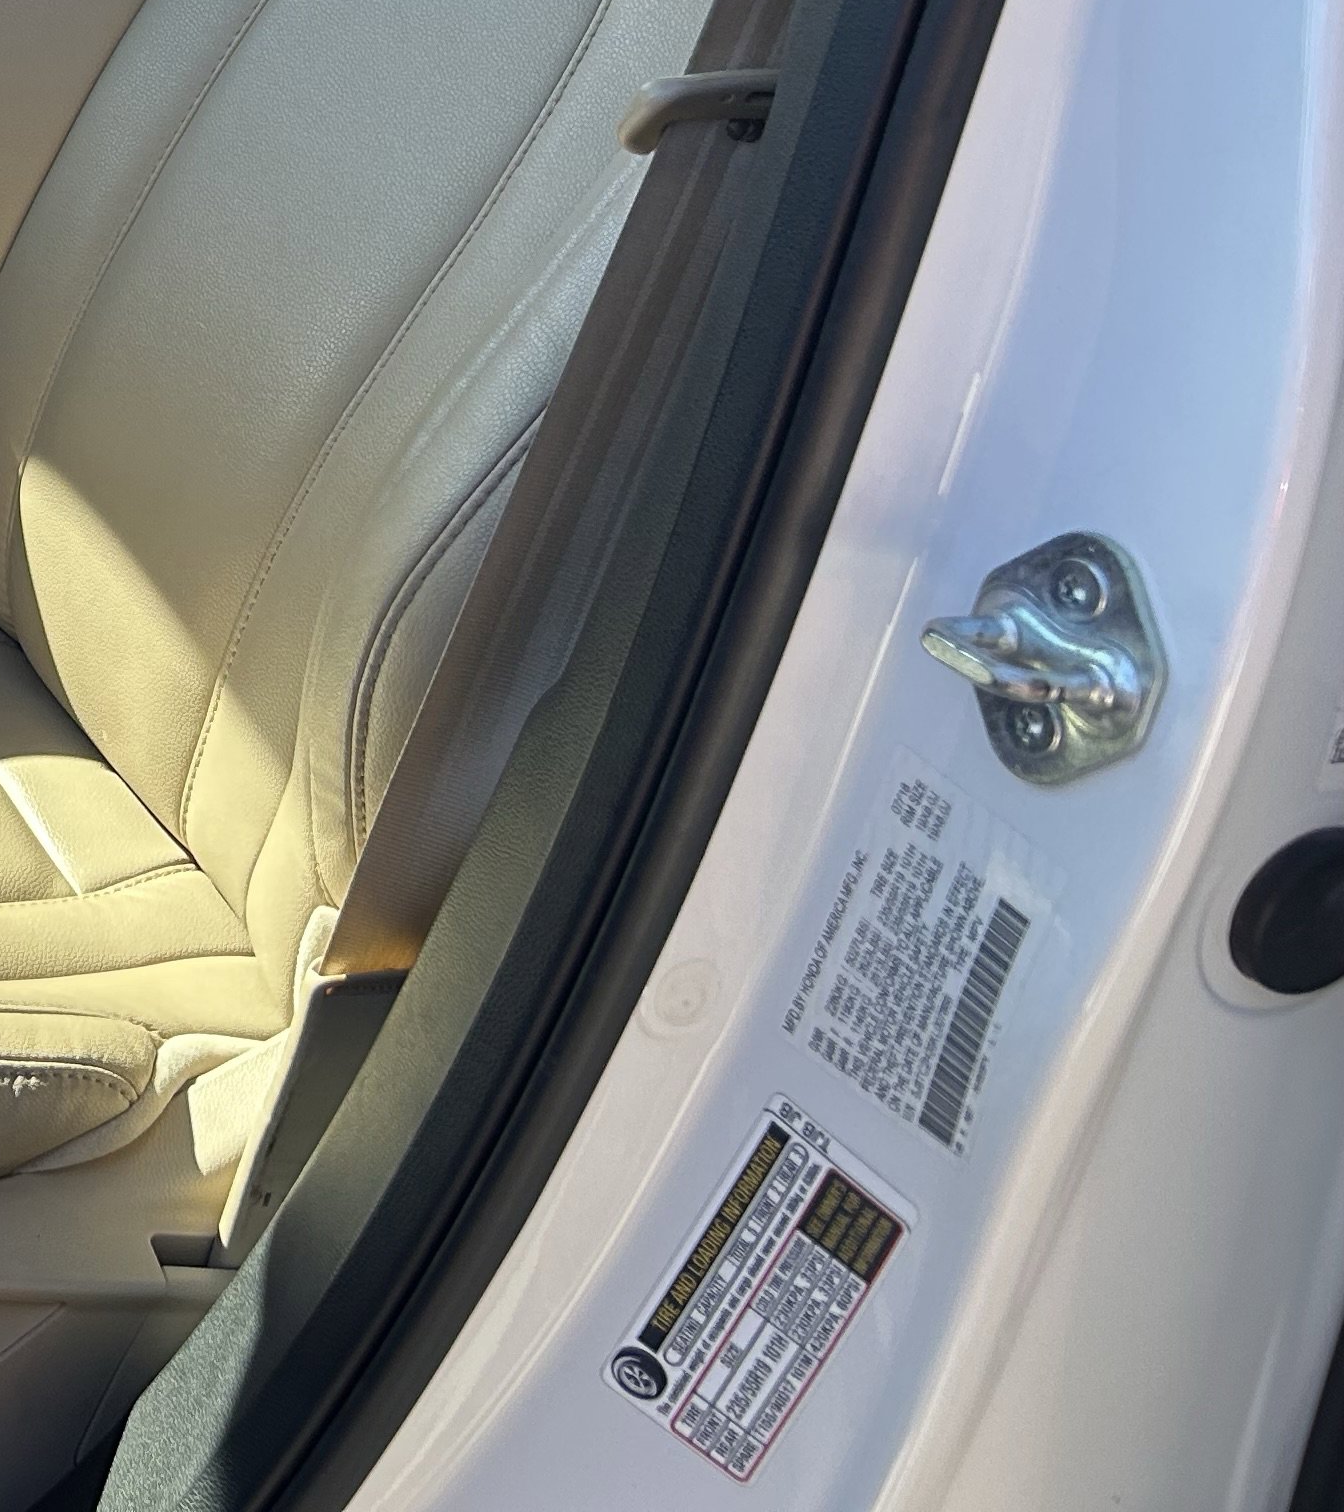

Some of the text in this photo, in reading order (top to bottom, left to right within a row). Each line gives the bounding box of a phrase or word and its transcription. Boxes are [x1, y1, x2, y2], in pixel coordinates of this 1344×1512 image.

[899, 777, 927, 829] RIM SIZE
[869, 846, 899, 900] TIRE SIZE
[908, 855, 944, 924] APPLICABLE
[945, 860, 972, 908] EFFECT
[819, 893, 849, 945] AMERICA
[901, 918, 918, 942] ALL
[943, 911, 968, 956] SHOWN
[812, 939, 830, 961] OF
[916, 916, 950, 983] STANDARDS
[797, 954, 823, 997] HONDA
[871, 953, 904, 1015] CONFORMS
[914, 953, 952, 1032] MANUFACTURE
[860, 922, 932, 1093] FEDERAL MOTOR VEHICLE SAFETY
[892, 980, 926, 1047] PREVENTION
[855, 1012, 882, 1058] VEHICLE
[881, 1044, 901, 1078] THEFT
[899, 1047, 917, 1075] DATE
[873, 1076, 891, 1103] AND
[887, 1093, 903, 1114] ON
[892, 1073, 908, 1095] THE
[800, 1119, 832, 1153] TJB
[650, 1132, 781, 1335] TIRE AND LOADING INFORMATION
[728, 1236, 751, 1264] TOTAL
[670, 1272, 728, 1357] SEATING CAPACITY
[718, 1341, 742, 1369] SIZE
[760, 1330, 790, 1364] 101H
[680, 1402, 703, 1429] TIRE
[695, 1411, 723, 1446] FRONT
[714, 1427, 738, 1457] REAR
